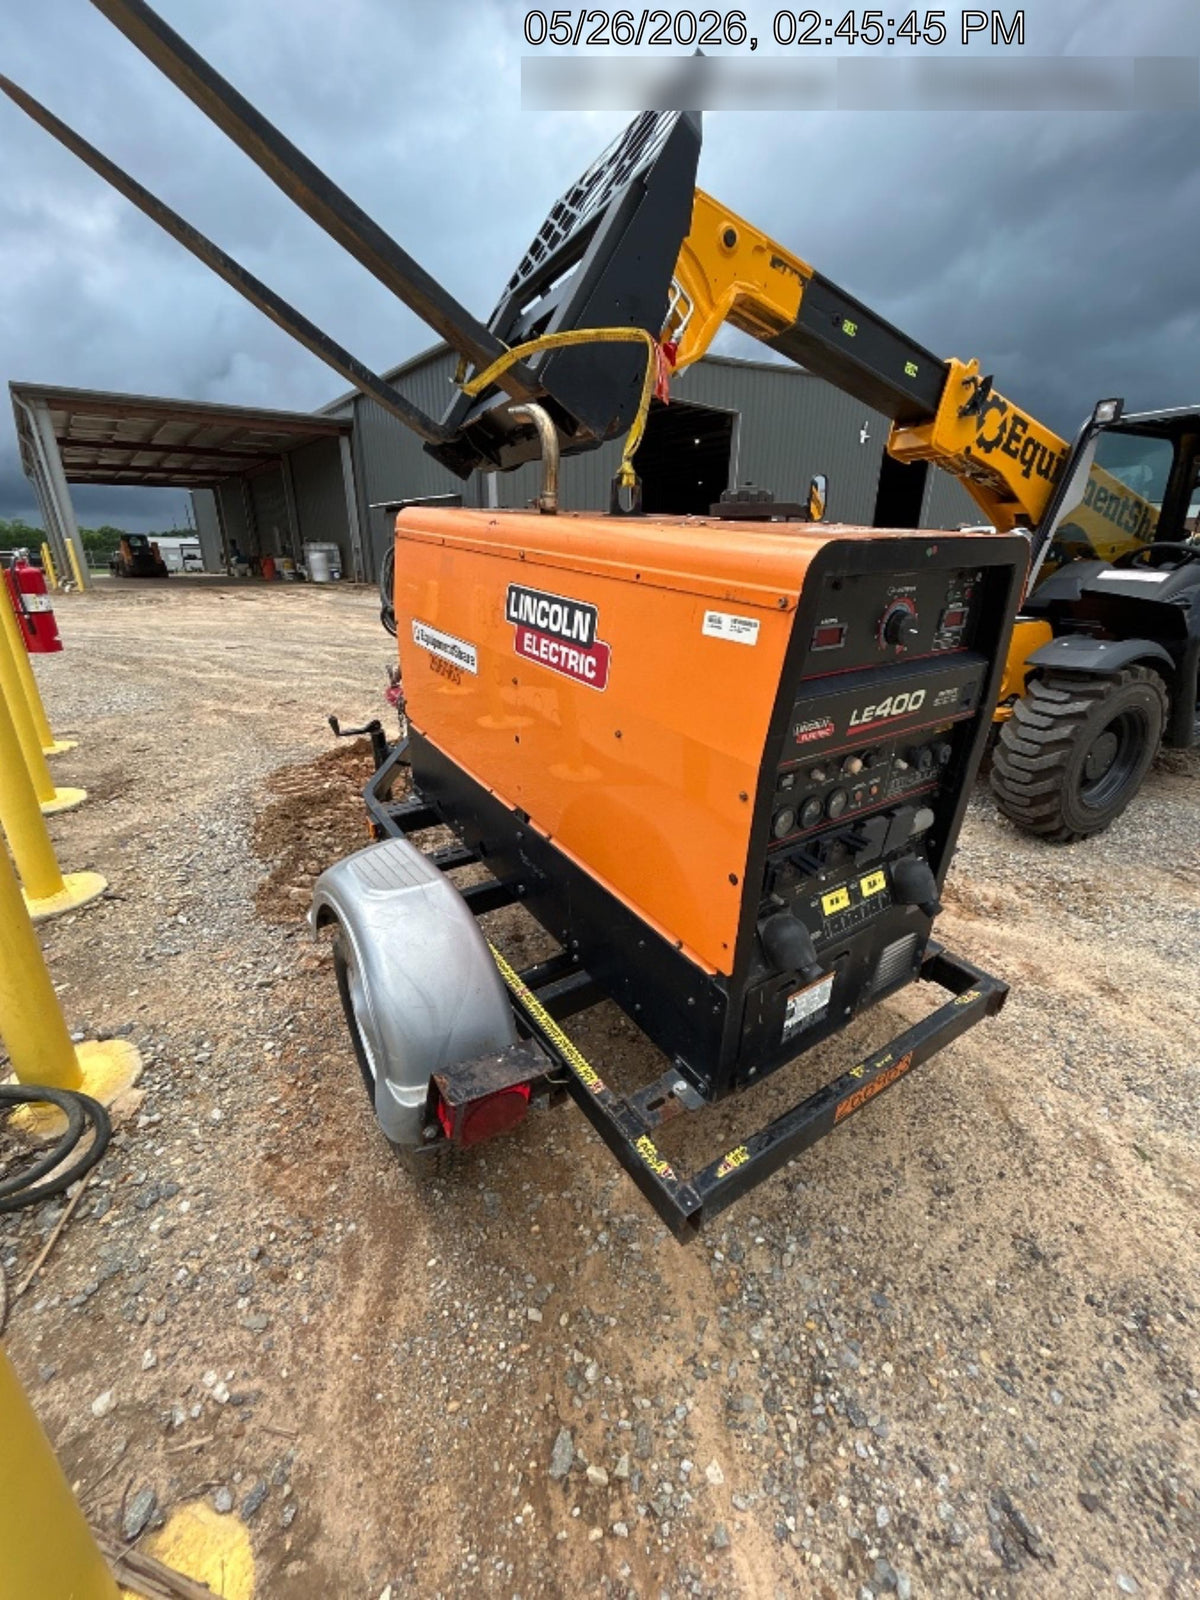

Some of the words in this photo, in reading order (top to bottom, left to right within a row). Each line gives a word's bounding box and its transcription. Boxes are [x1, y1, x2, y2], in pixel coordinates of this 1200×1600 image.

[510, 591, 591, 643] LINCOLN
[523, 632, 597, 679] ELECTRIC
[848, 689, 927, 727] LE400
